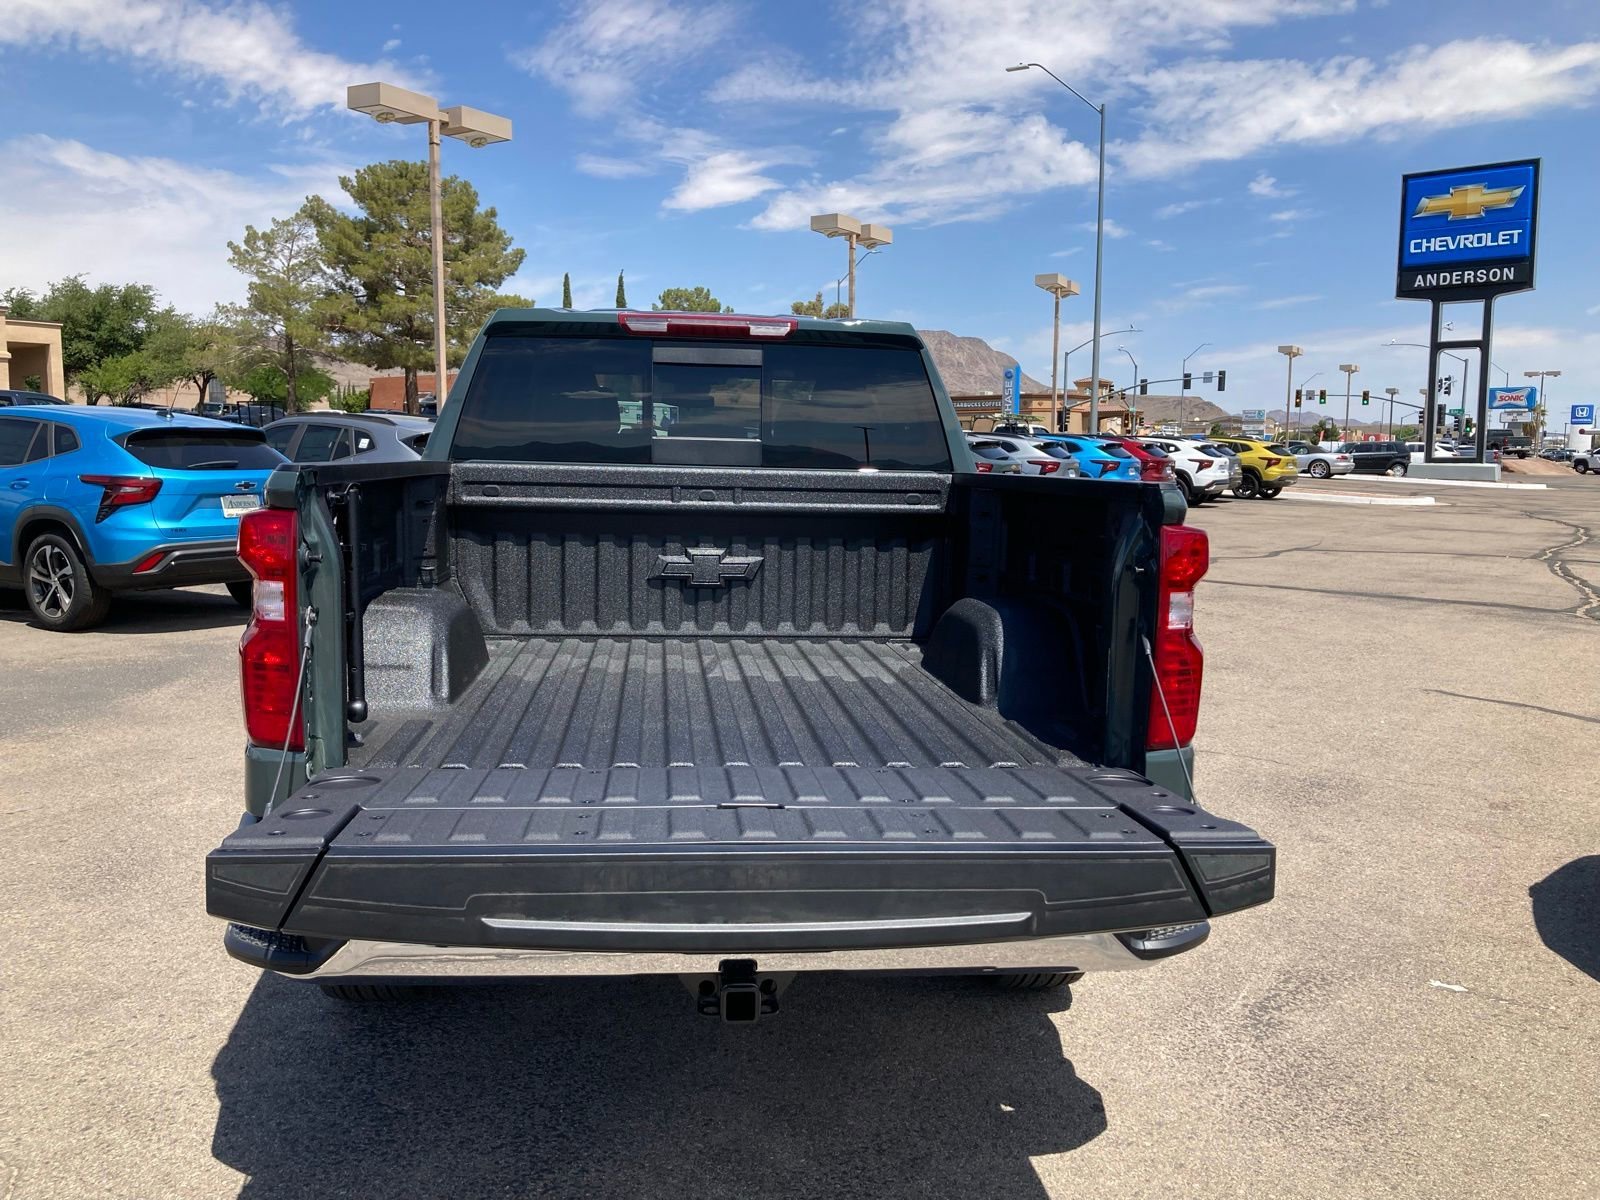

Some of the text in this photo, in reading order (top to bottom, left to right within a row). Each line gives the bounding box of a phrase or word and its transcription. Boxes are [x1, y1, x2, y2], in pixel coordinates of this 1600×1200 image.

[1409, 229, 1523, 254] CHEVROLET
[1413, 266, 1515, 288] ANDERSON
[1497, 394, 1525, 402] SONIC
